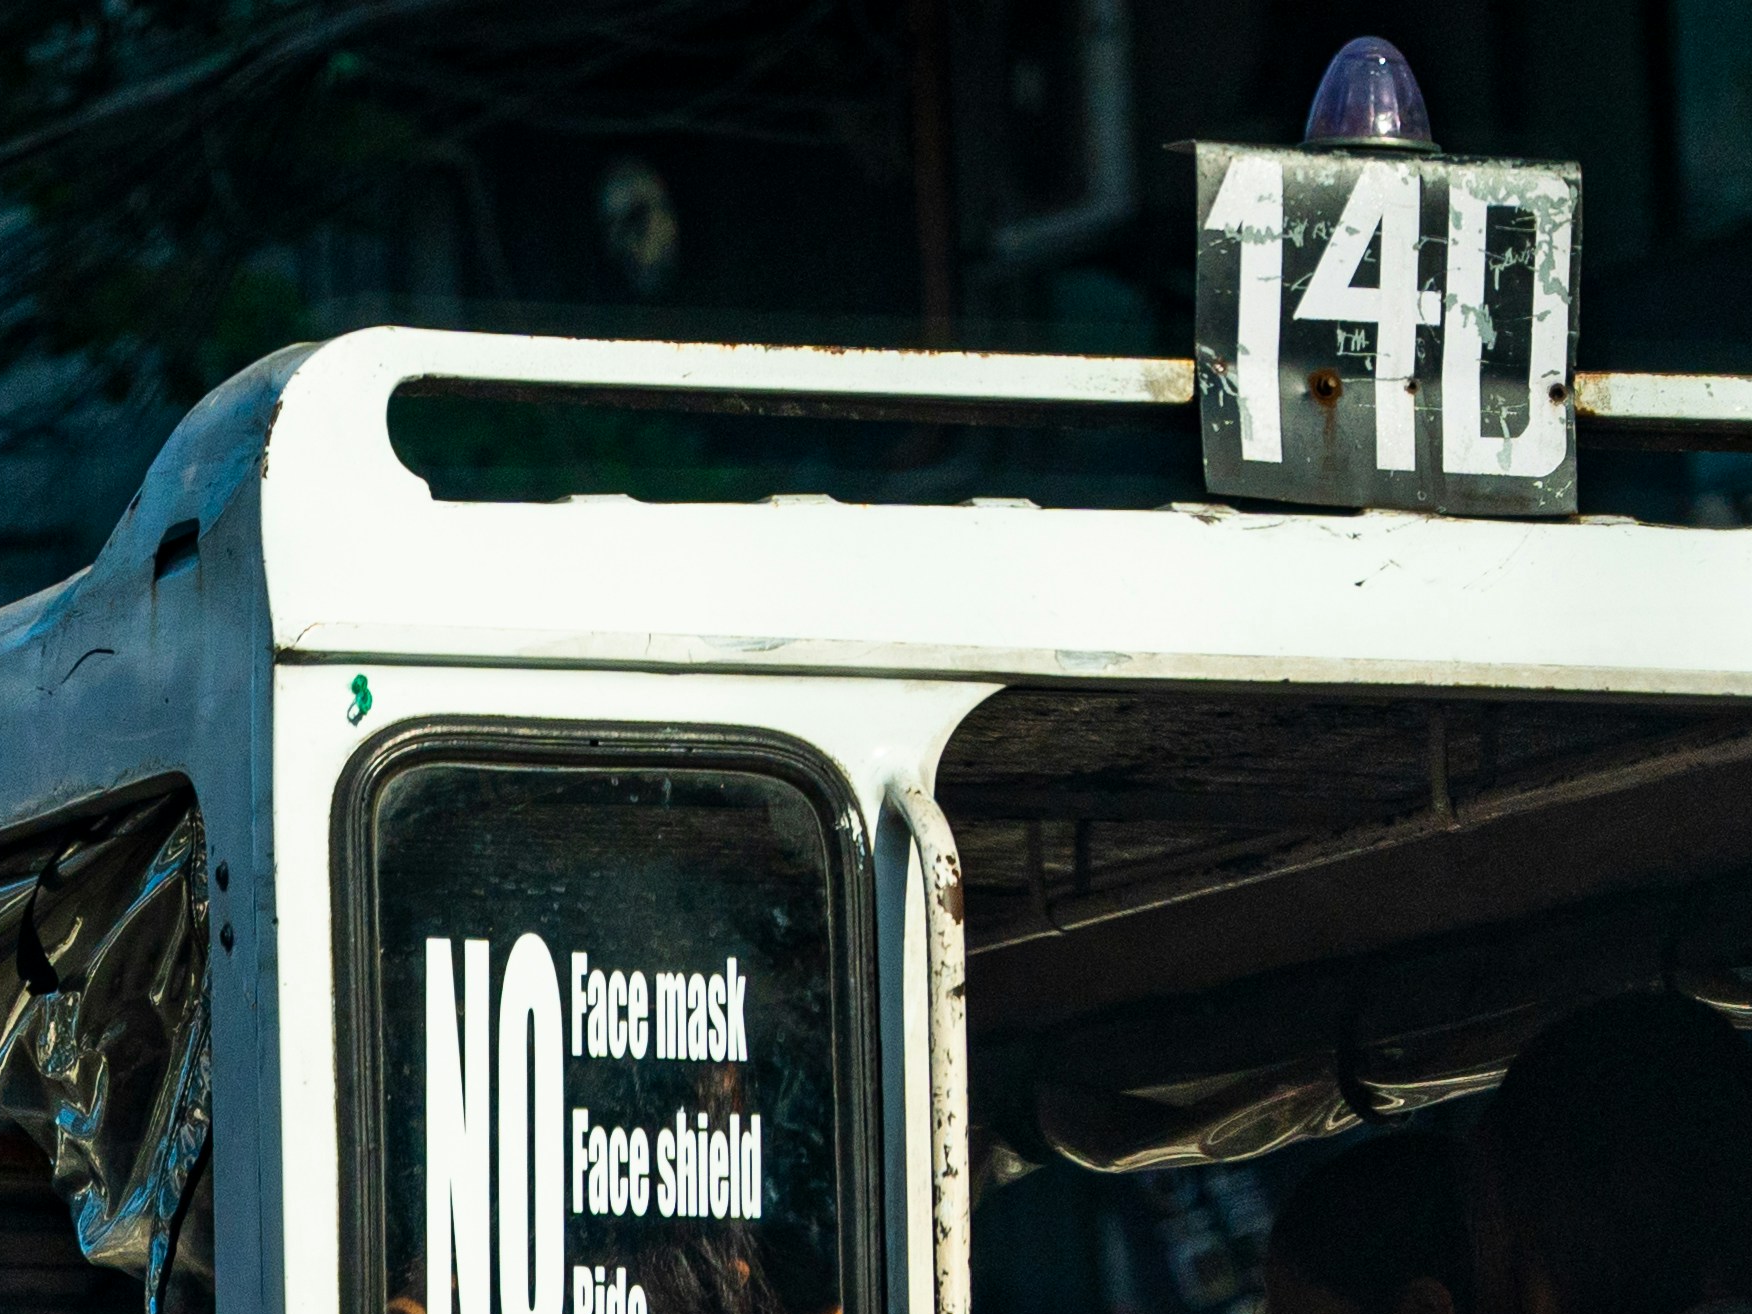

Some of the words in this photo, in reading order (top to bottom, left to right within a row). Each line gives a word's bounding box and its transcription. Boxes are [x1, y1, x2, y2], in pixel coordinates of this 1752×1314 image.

[1204, 156, 1572, 478] 14D
[571, 951, 650, 1059] Face
[655, 956, 748, 1062] mask
[572, 1108, 650, 1217] Face
[656, 1107, 762, 1220] shield
